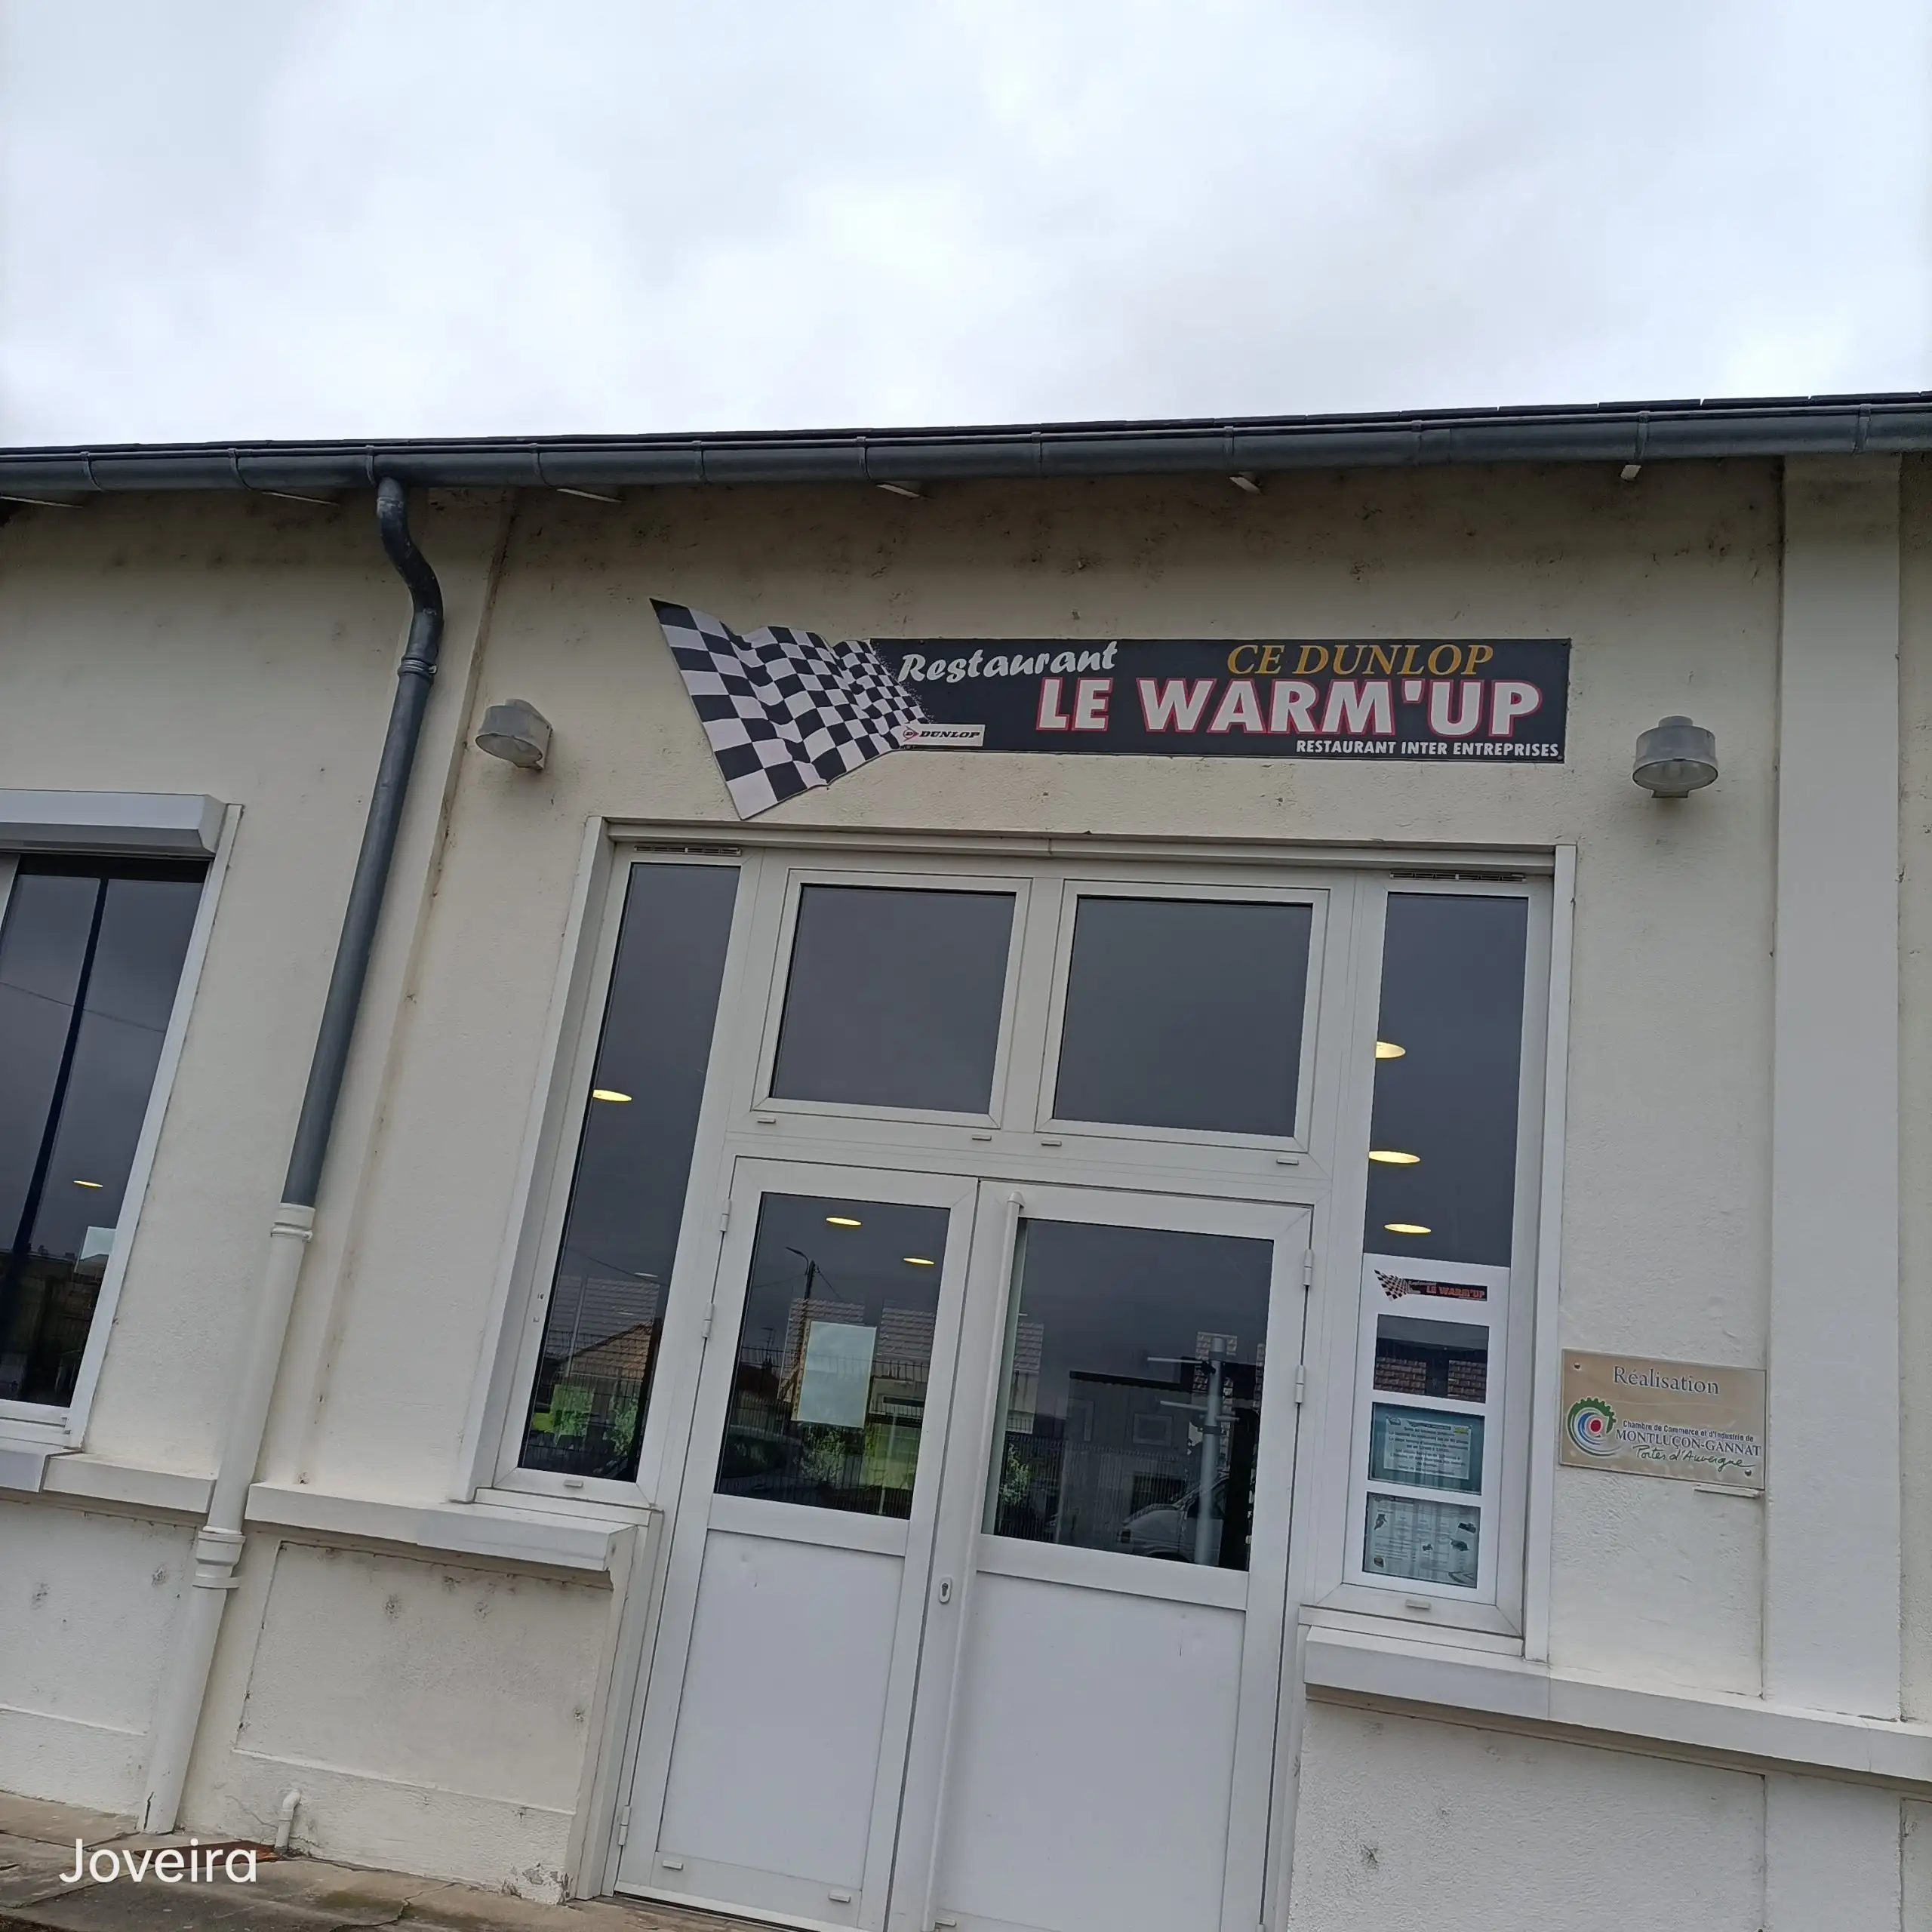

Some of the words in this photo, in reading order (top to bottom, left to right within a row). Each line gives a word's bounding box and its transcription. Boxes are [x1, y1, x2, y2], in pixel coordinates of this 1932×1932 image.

[898, 641, 1118, 684] Restaurant
[1227, 644, 1285, 675] CE
[1292, 644, 1494, 676] DUNLOP
[1036, 677, 1114, 731] LE
[1136, 678, 1543, 737] WARM'UP
[918, 731, 981, 739] DUNLOP
[1296, 740, 1396, 755] RESTAURANT
[1401, 741, 1447, 756] INTER
[1453, 741, 1559, 758] ENTREPRISES
[1426, 1285, 1437, 1294] LE
[1614, 1365, 1718, 1395] Réalisation
[1616, 1429, 1761, 1457] MONTLUÇON-GANNAT
[1623, 1420, 1653, 1431] Chambre
[1663, 1425, 1699, 1435] Commerce
[1709, 1431, 1744, 1441] d'Industrie
[1632, 1444, 1666, 1460] Portes
[1669, 1449, 1755, 1472] d'Auvergne
